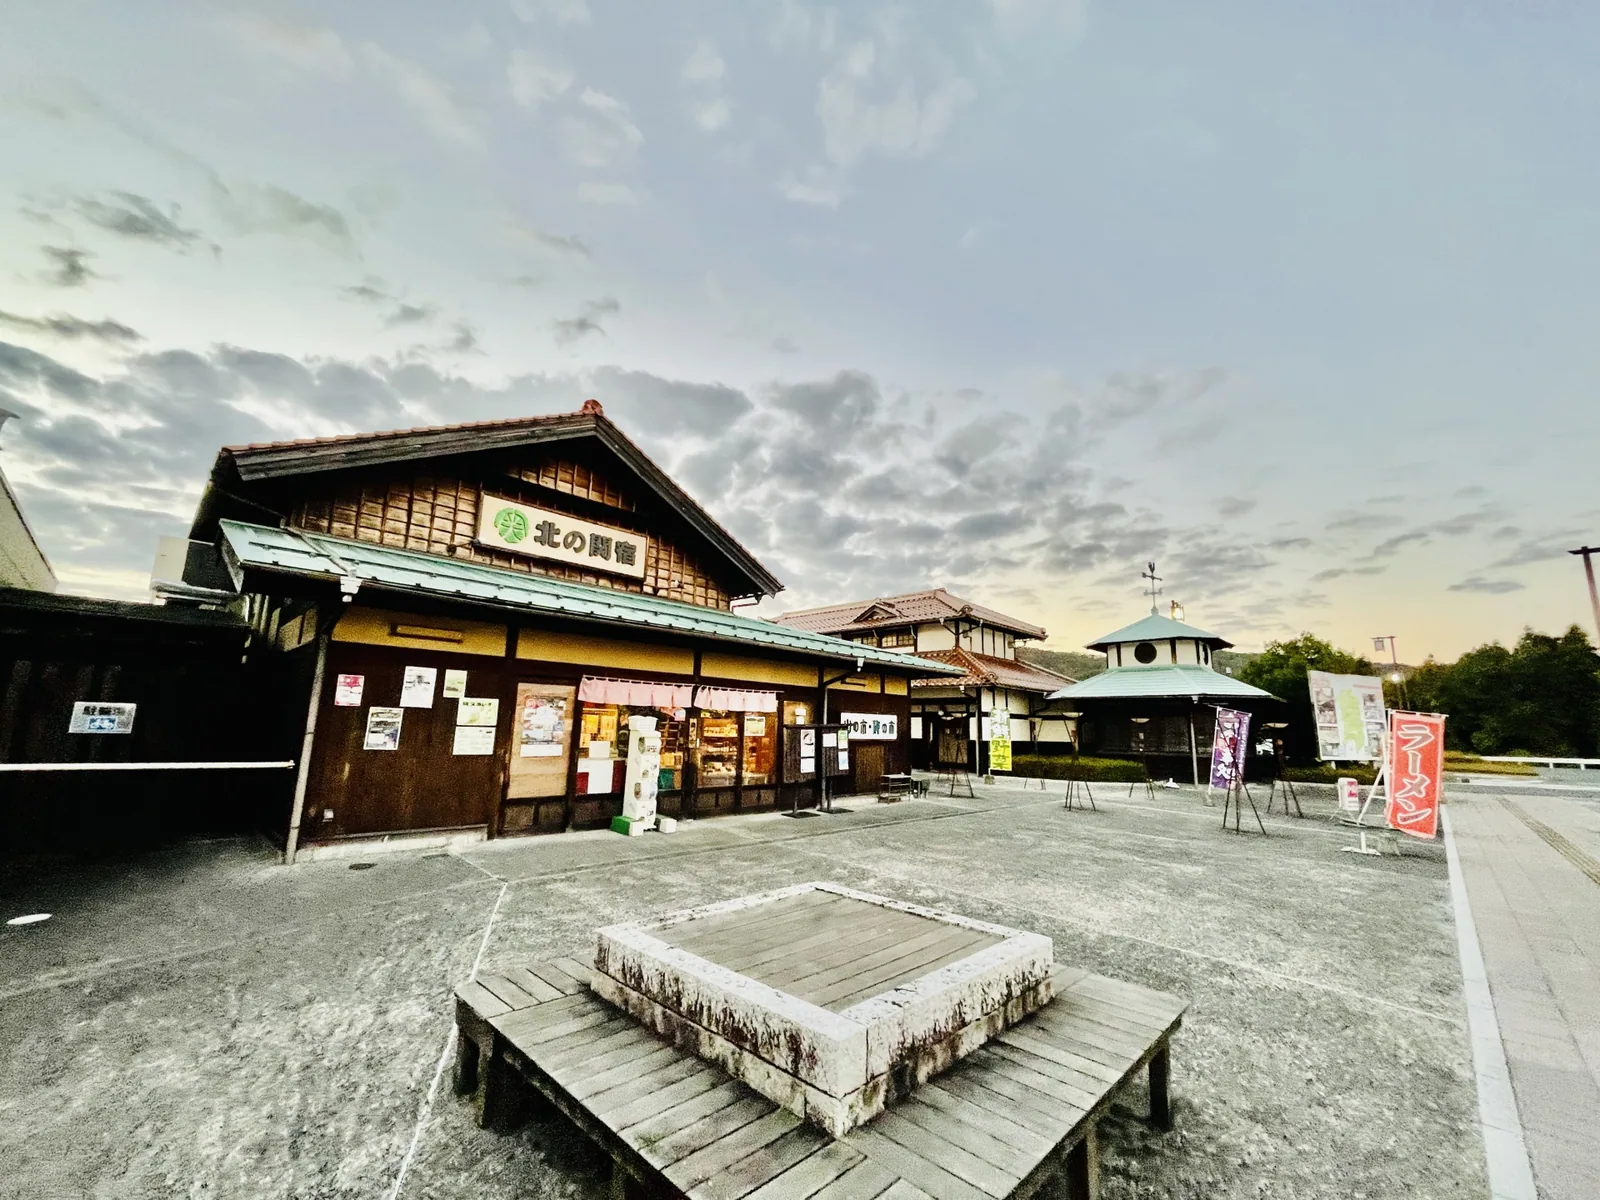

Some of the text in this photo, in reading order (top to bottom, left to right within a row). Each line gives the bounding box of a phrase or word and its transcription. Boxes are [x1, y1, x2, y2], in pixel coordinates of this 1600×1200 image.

[533, 520, 637, 566] 北の関宿
[1397, 724, 1435, 824] ラーメン
